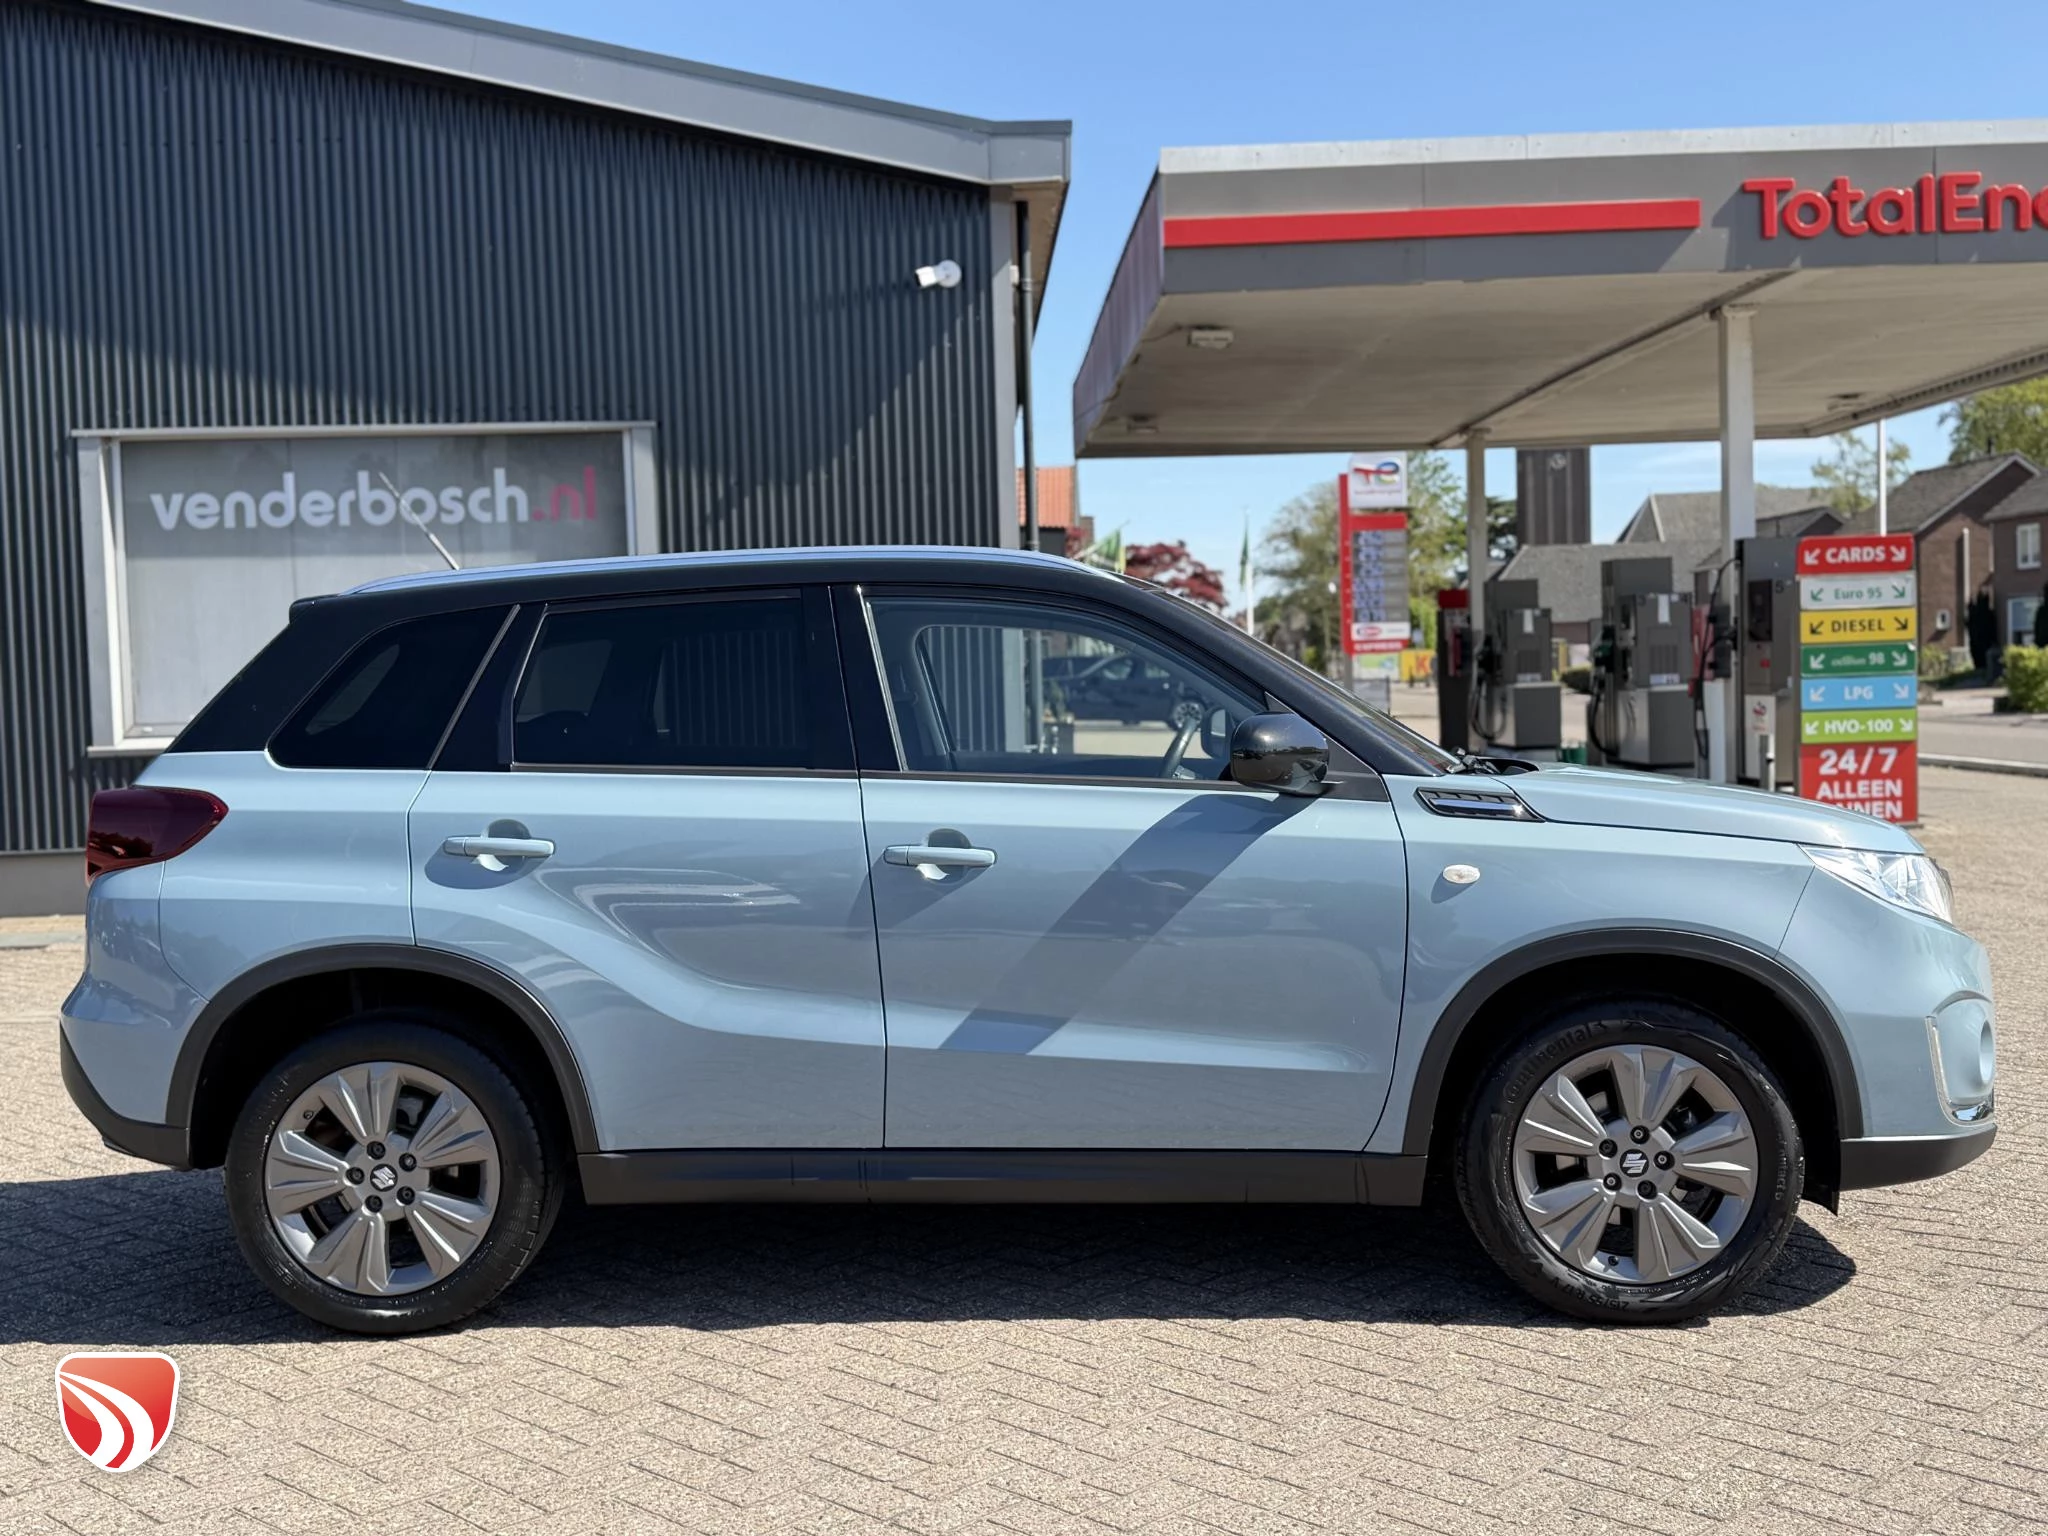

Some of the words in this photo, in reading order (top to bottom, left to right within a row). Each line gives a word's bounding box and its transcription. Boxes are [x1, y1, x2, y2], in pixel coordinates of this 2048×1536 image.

[148, 465, 597, 531] venderbosch.nl
[1825, 545, 1886, 564] CARDS
[1834, 588, 1863, 600] Euro
[1867, 587, 1883, 599] 95
[1831, 619, 1885, 633] DIESEL
[1844, 685, 1874, 700] LPG
[1824, 718, 1894, 734] HVO-100
[1819, 747, 1898, 775] 24/7
[1815, 779, 1903, 800] ALLEEN
